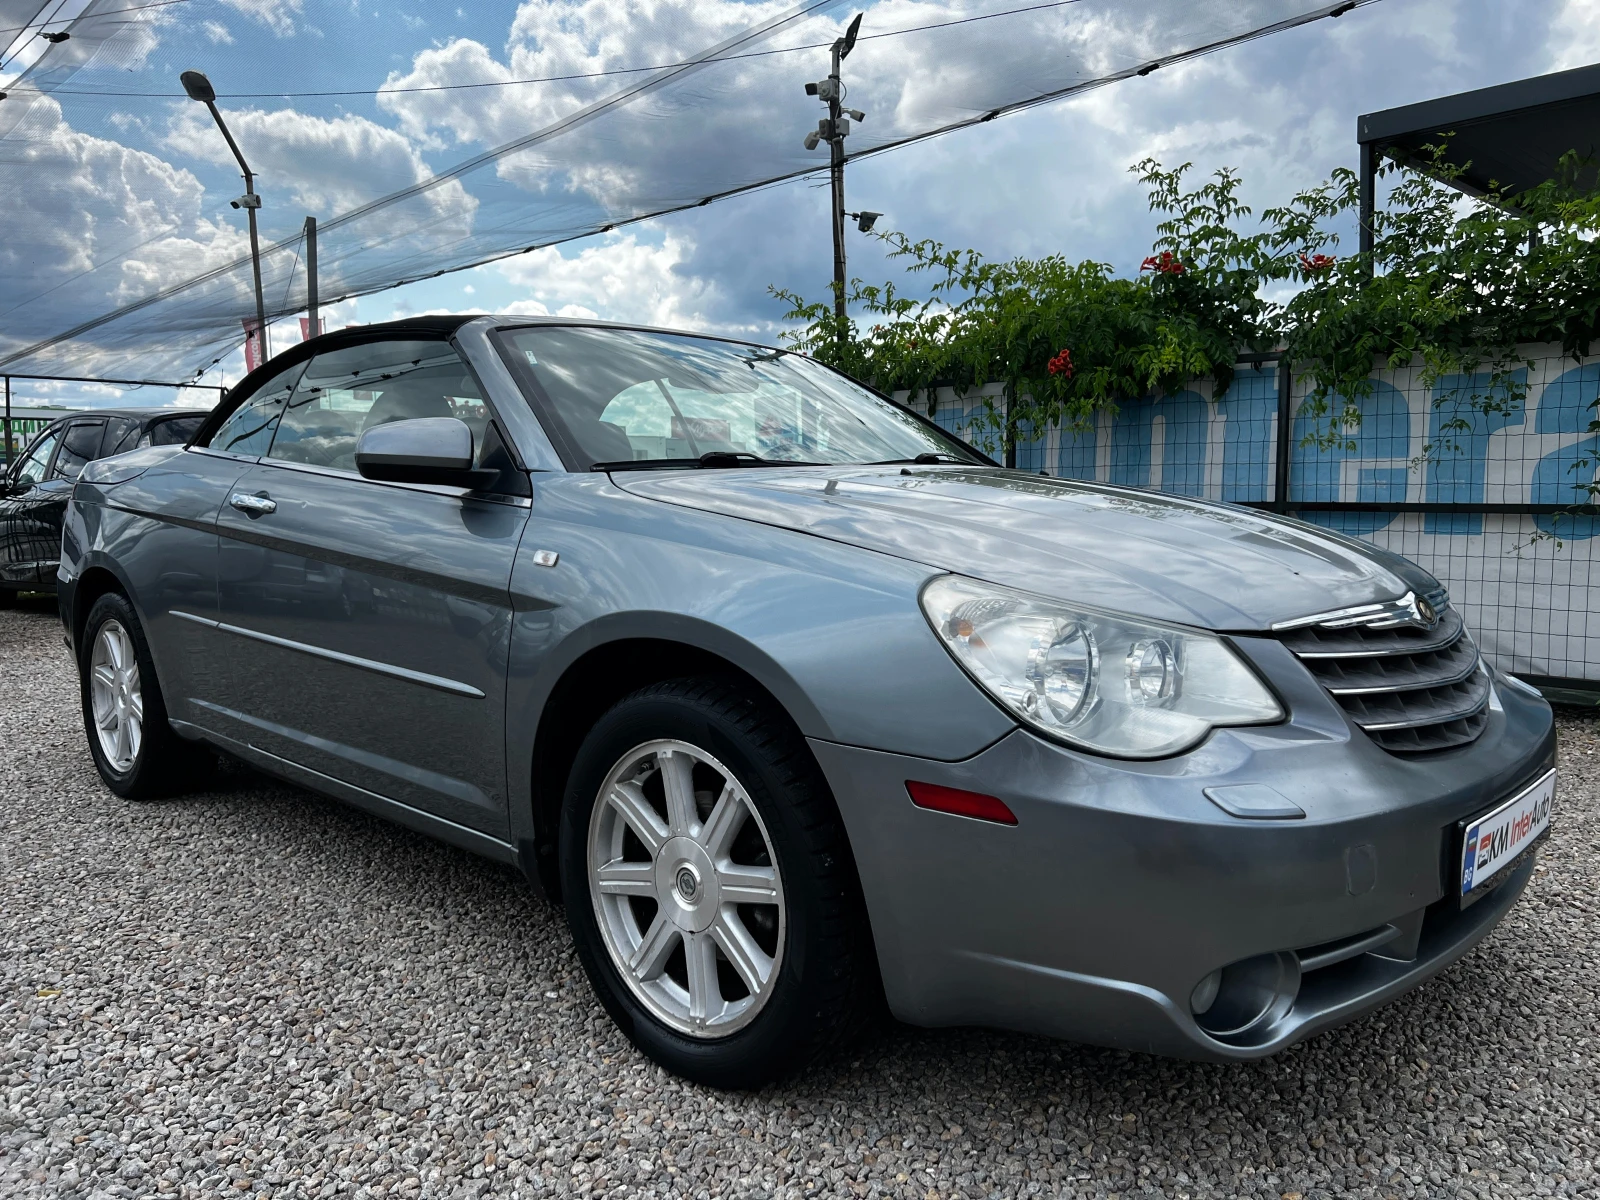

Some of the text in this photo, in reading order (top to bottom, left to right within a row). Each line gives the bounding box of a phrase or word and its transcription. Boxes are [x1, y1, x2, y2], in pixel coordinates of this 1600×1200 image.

[1489, 792, 1550, 862] KM InterAuto
[1463, 866, 1473, 884] BG
